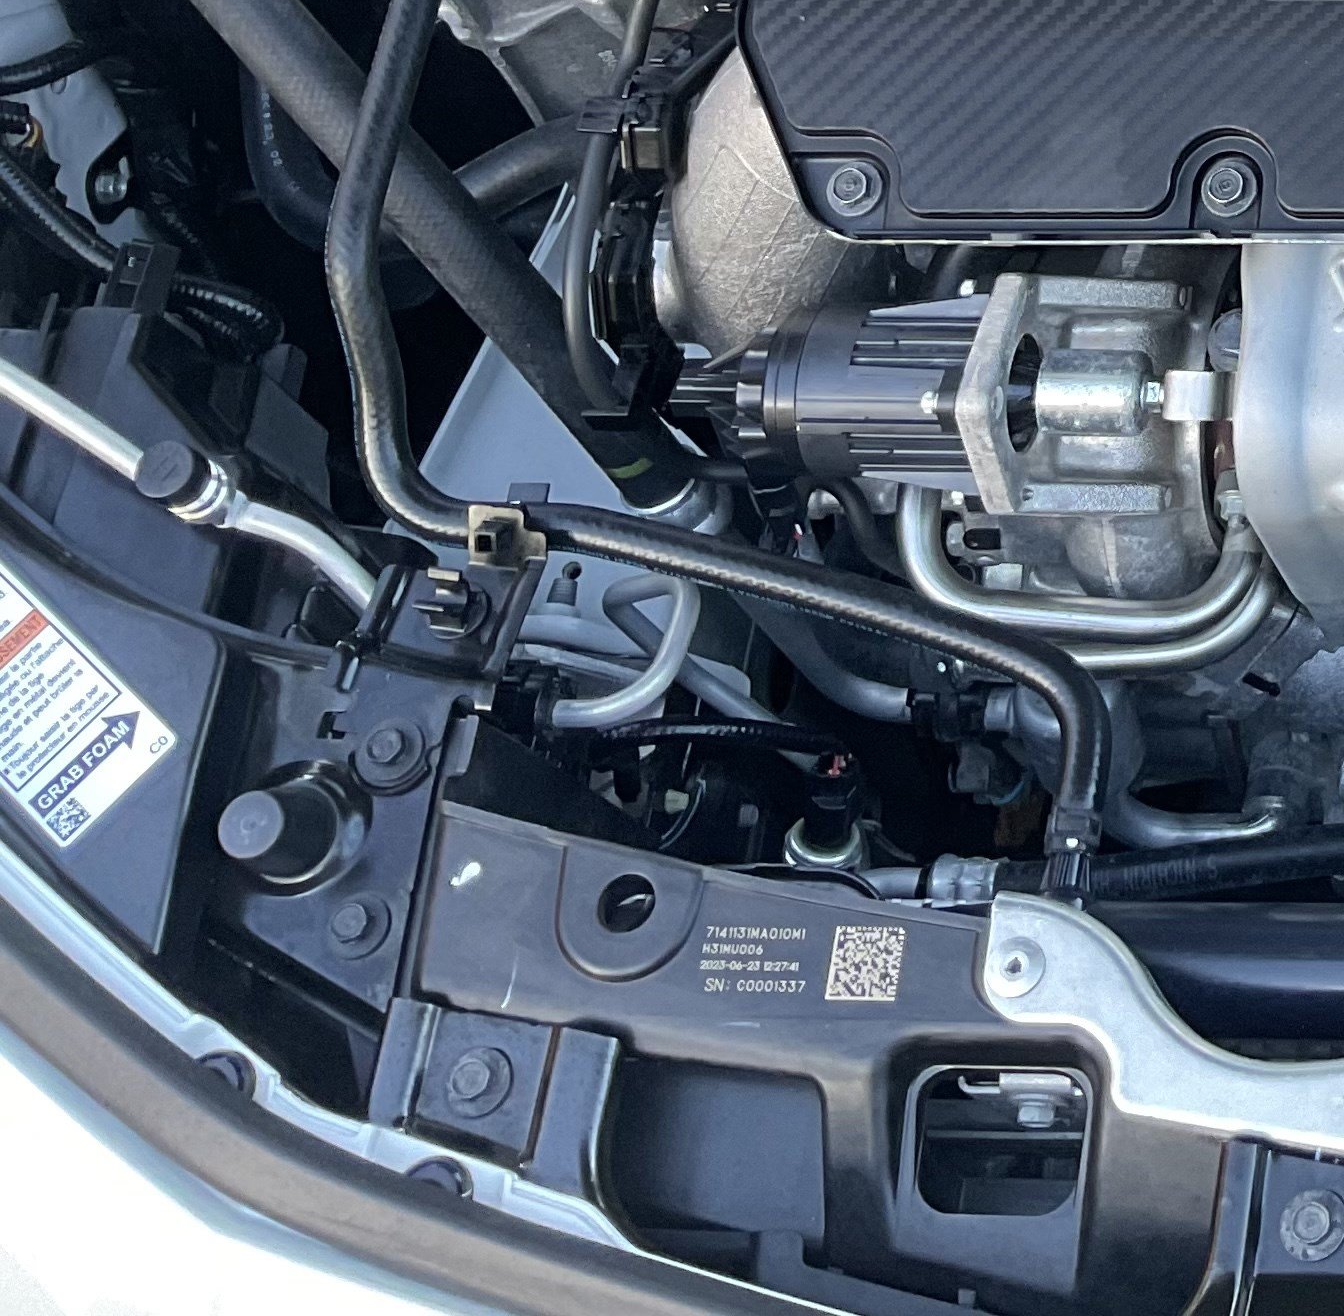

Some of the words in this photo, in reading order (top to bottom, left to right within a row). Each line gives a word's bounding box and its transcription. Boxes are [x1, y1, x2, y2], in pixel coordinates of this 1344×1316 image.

[85, 684, 100, 699] par
[31, 697, 52, 718] peut
[35, 763, 84, 810] GRAB
[80, 719, 130, 767] FOAM
[700, 959, 761, 971] 2023-06-23
[704, 977, 731, 992] SN:
[736, 979, 806, 993] C0001337
